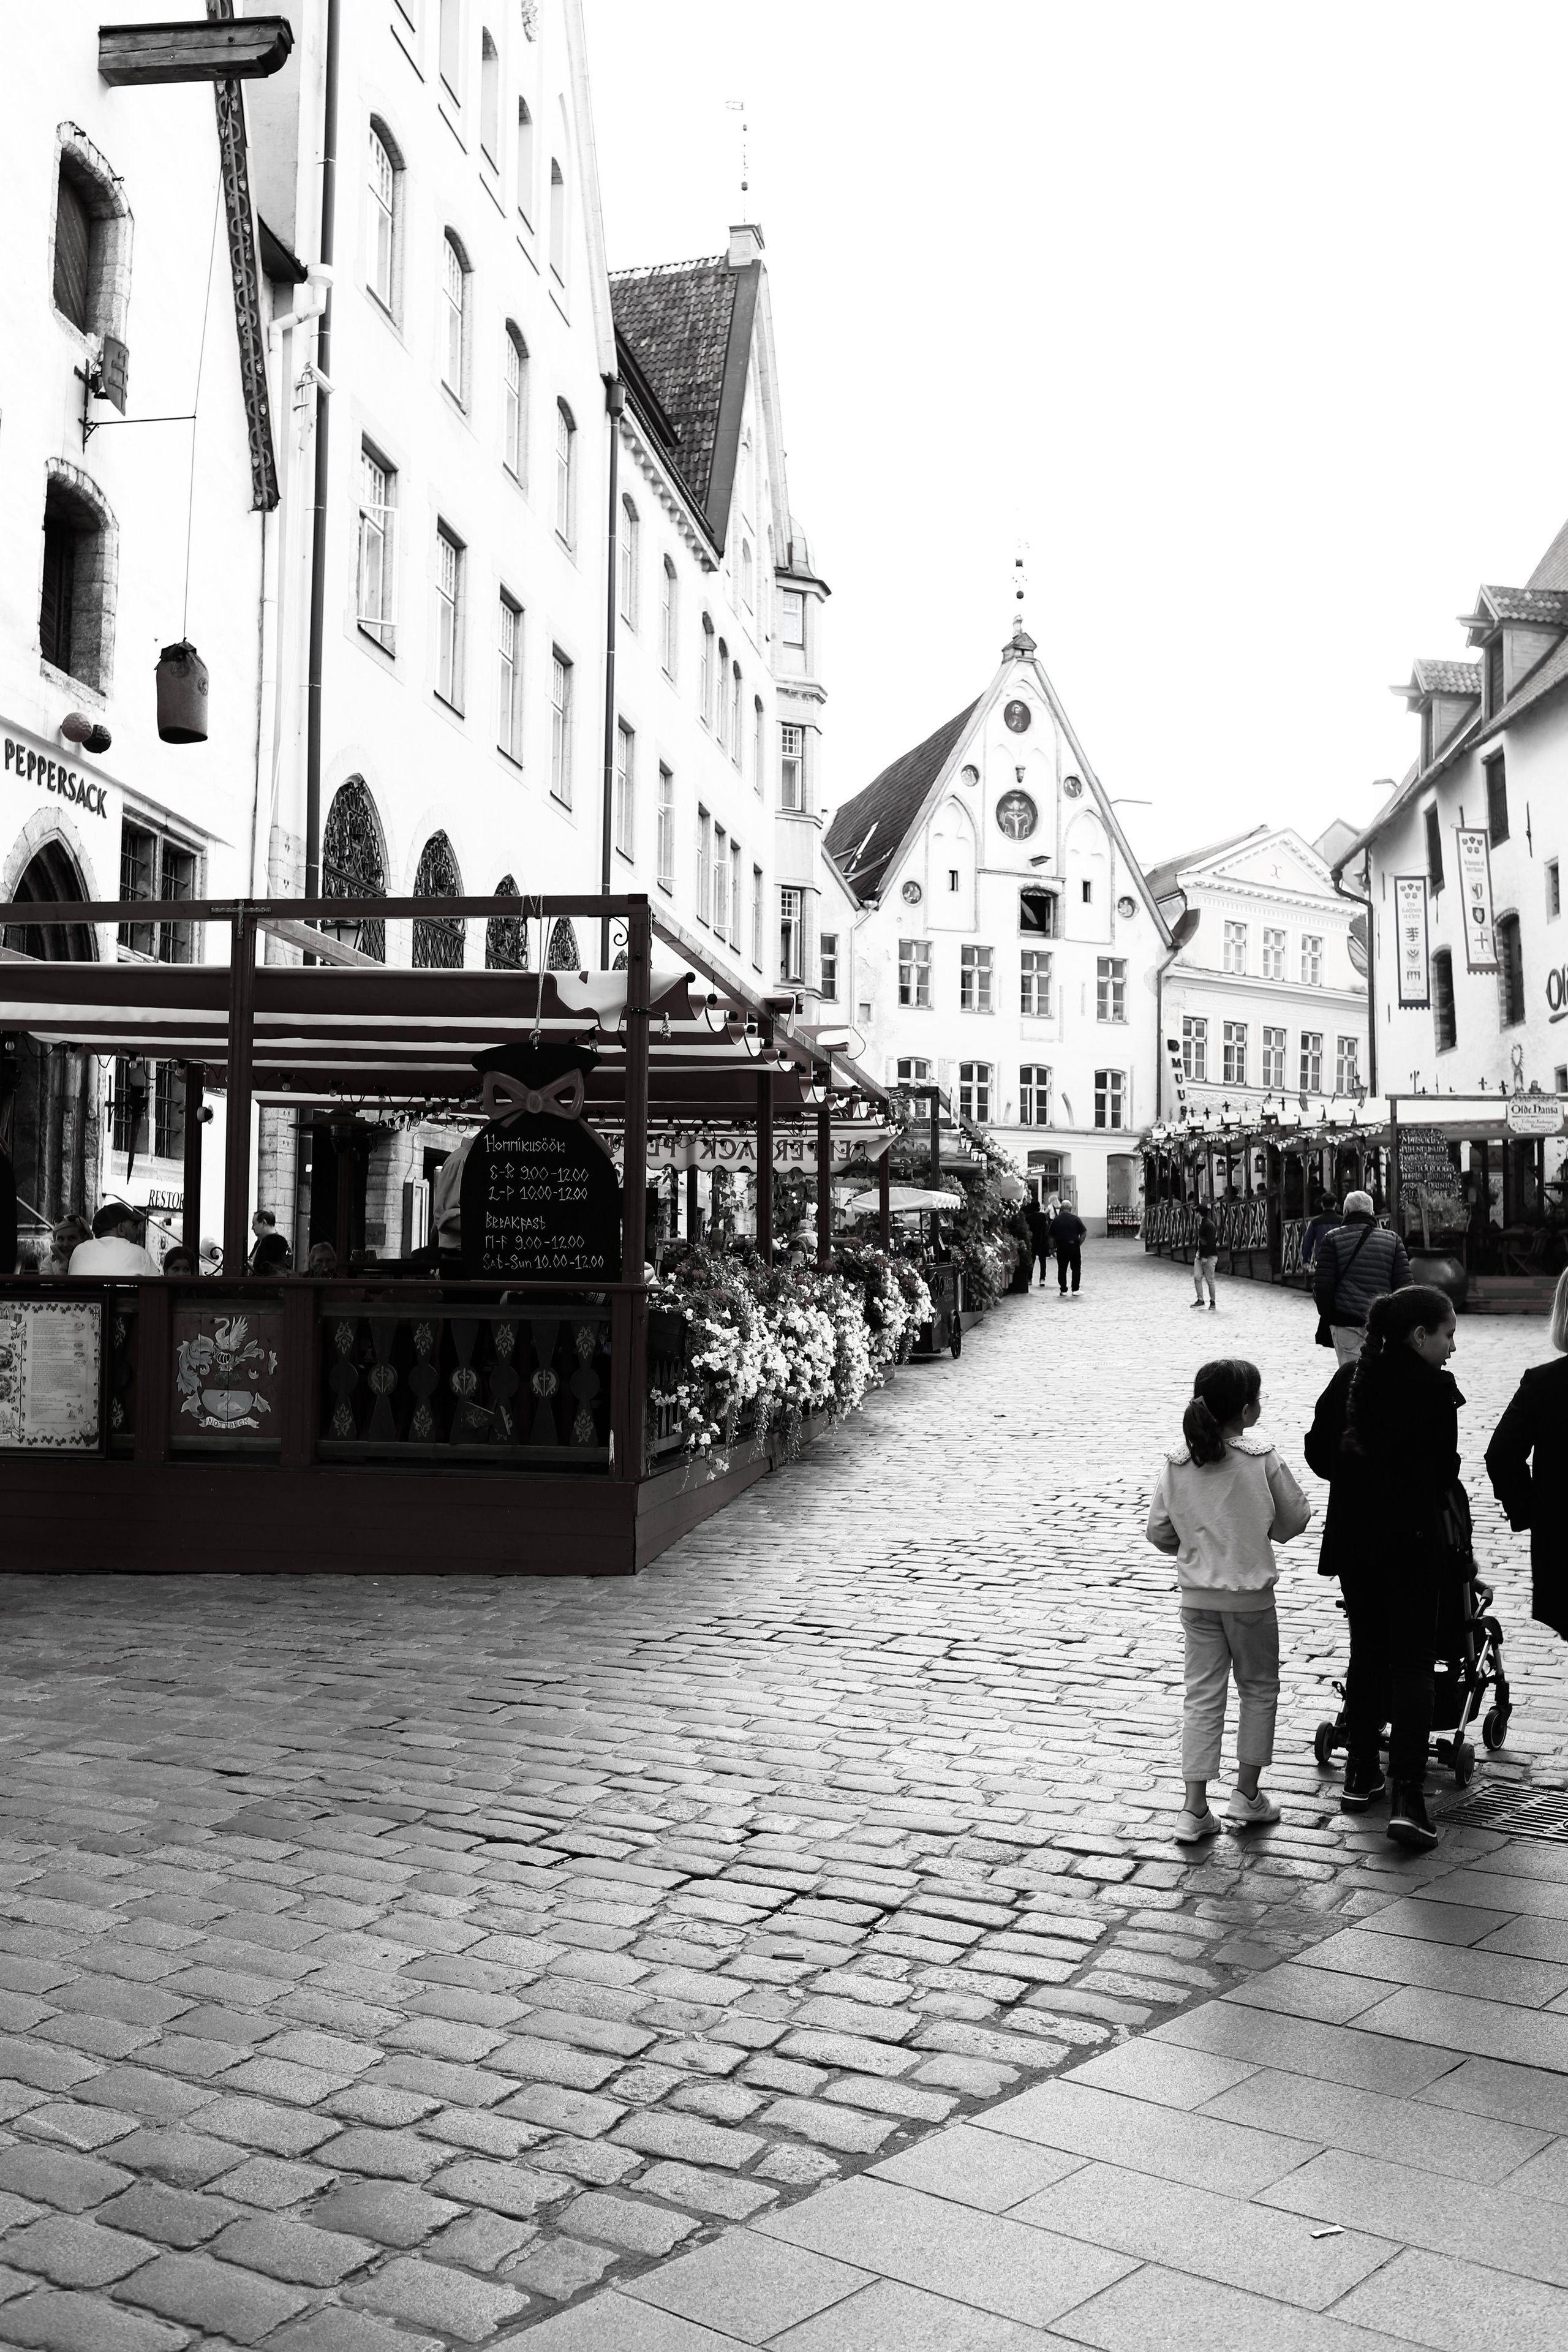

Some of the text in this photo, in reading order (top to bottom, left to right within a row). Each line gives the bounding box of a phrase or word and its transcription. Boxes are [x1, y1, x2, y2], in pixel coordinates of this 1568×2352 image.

[5, 738, 108, 818] PEPPERSACK
[1546, 962, 1568, 1011] Ol
[1511, 1104, 1558, 1115] Olde Hansa
[483, 1134, 565, 1153] Hommikusöök
[520, 1166, 589, 1183] 9.00-12.00
[488, 1185, 588, 1201] L-P 10.00-12.00
[484, 1235, 586, 1251] M-F 9.00-12.00
[535, 1254, 605, 1270] 10.00-12.00
[208, 1417, 249, 1429] NOTTBECK
